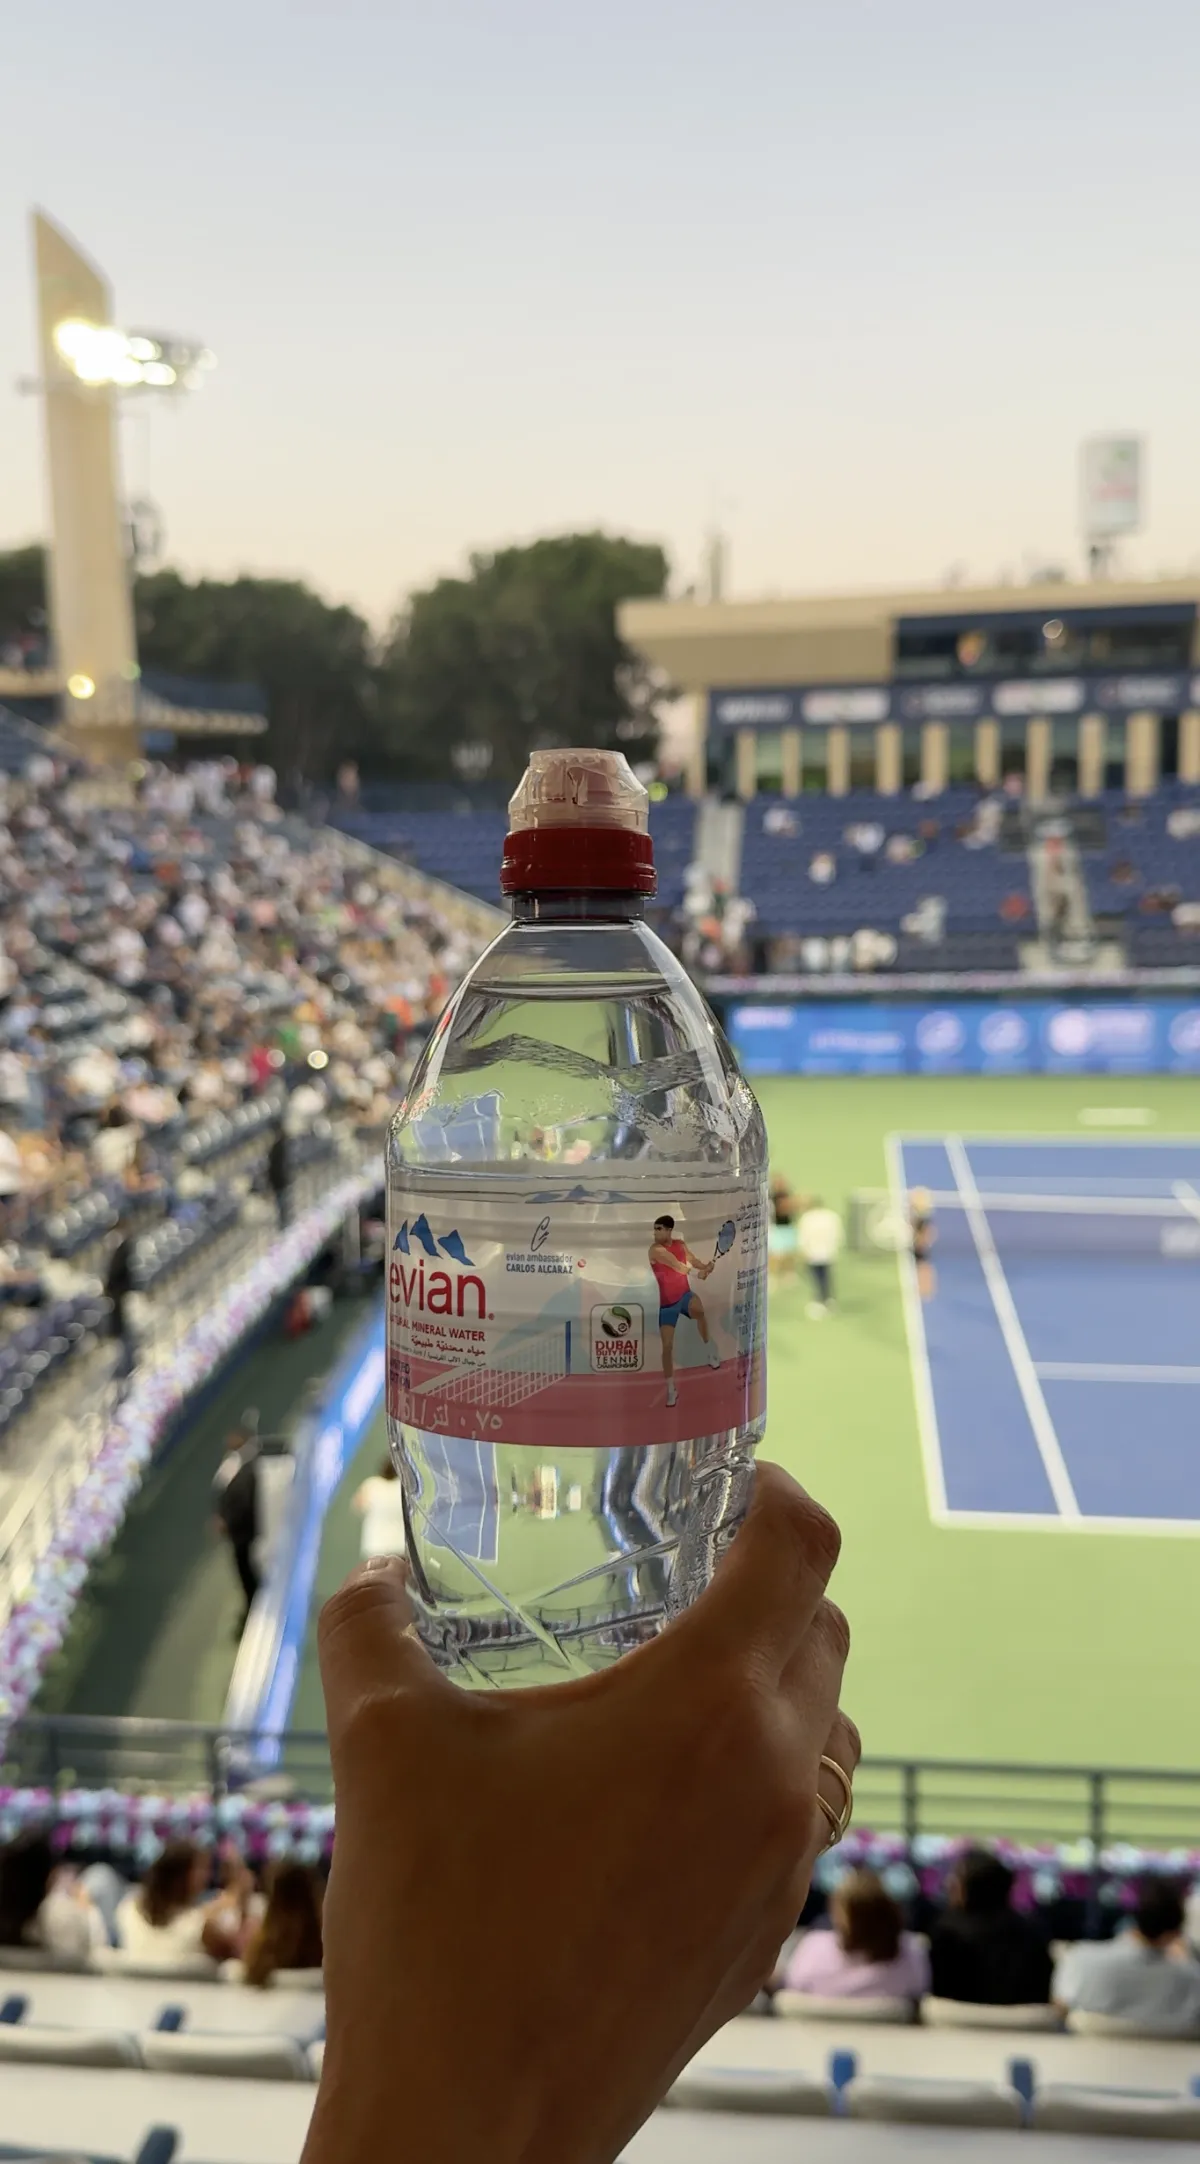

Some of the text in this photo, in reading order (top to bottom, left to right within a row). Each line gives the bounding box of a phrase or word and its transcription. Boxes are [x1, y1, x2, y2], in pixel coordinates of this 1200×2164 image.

[506, 1253, 573, 1264] evian ambassador
[506, 1263, 573, 1274] CARLOS ALCARAZ
[390, 1259, 486, 1319] evian
[411, 1320, 447, 1338] MINERAL
[449, 1328, 486, 1342] WATER
[595, 1339, 639, 1351] DUBAI
[467, 1345, 486, 1358] مياه
[596, 1356, 640, 1365] TENNIS
